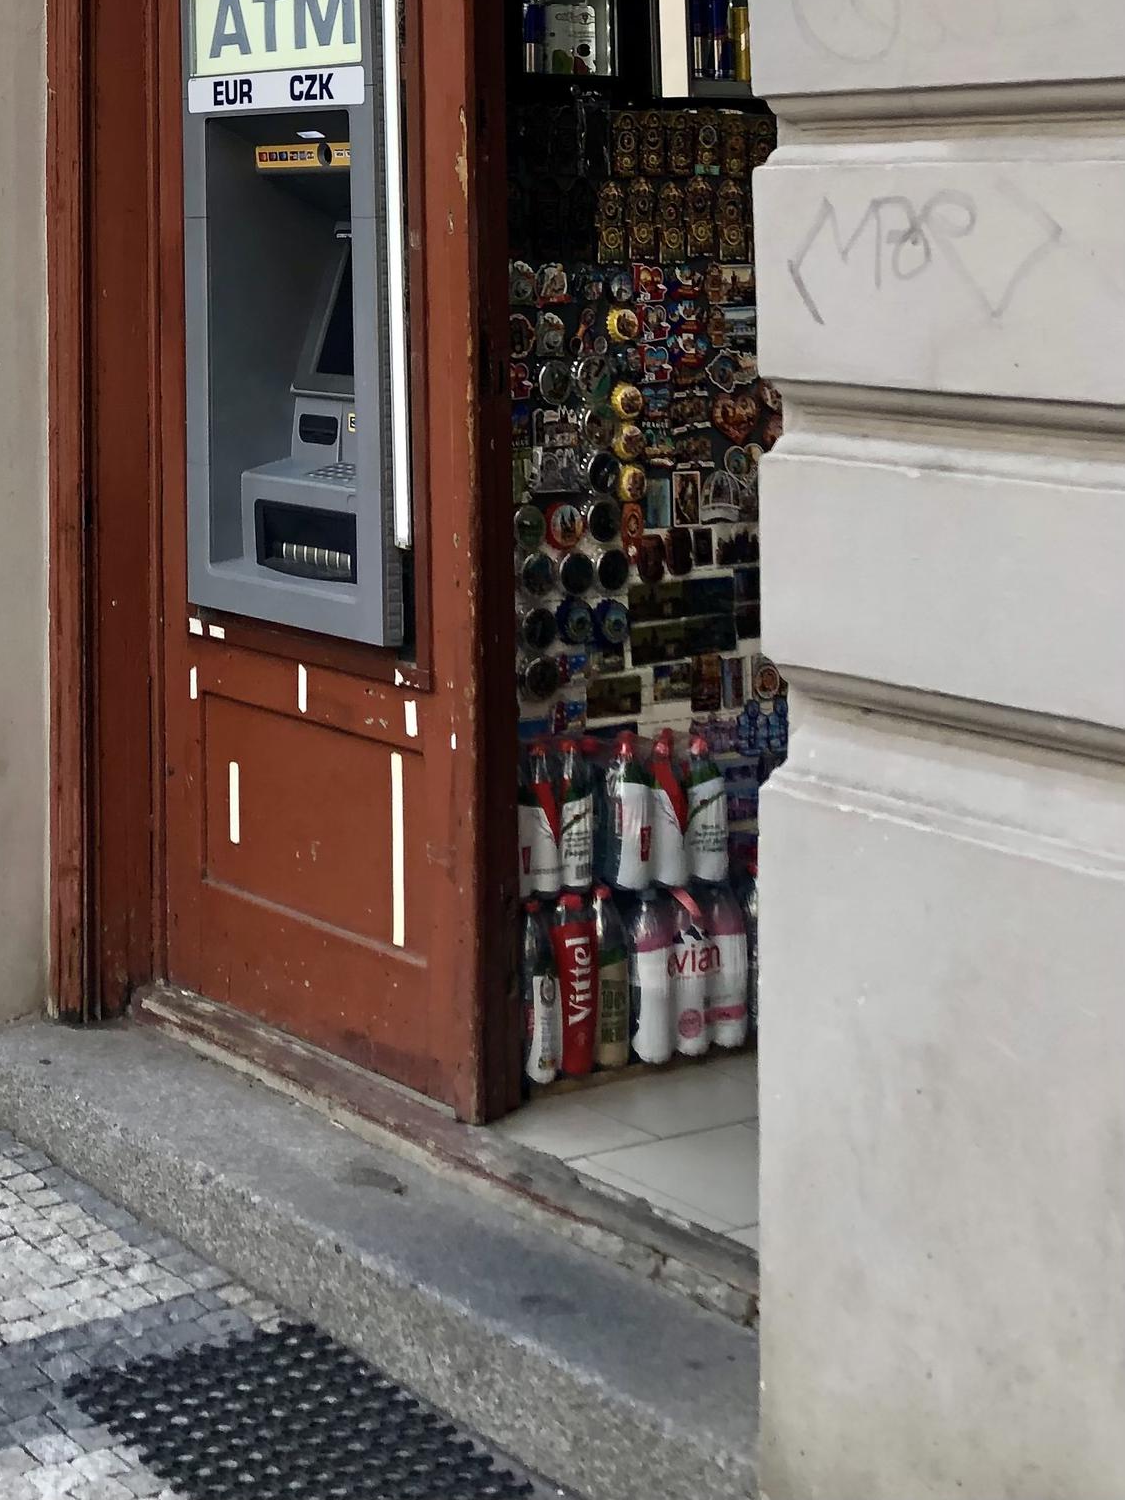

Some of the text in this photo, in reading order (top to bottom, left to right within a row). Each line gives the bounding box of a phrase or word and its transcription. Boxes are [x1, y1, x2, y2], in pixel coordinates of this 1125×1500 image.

[213, 72, 334, 106] EUR CZK
[565, 936, 592, 1027] Vittel
